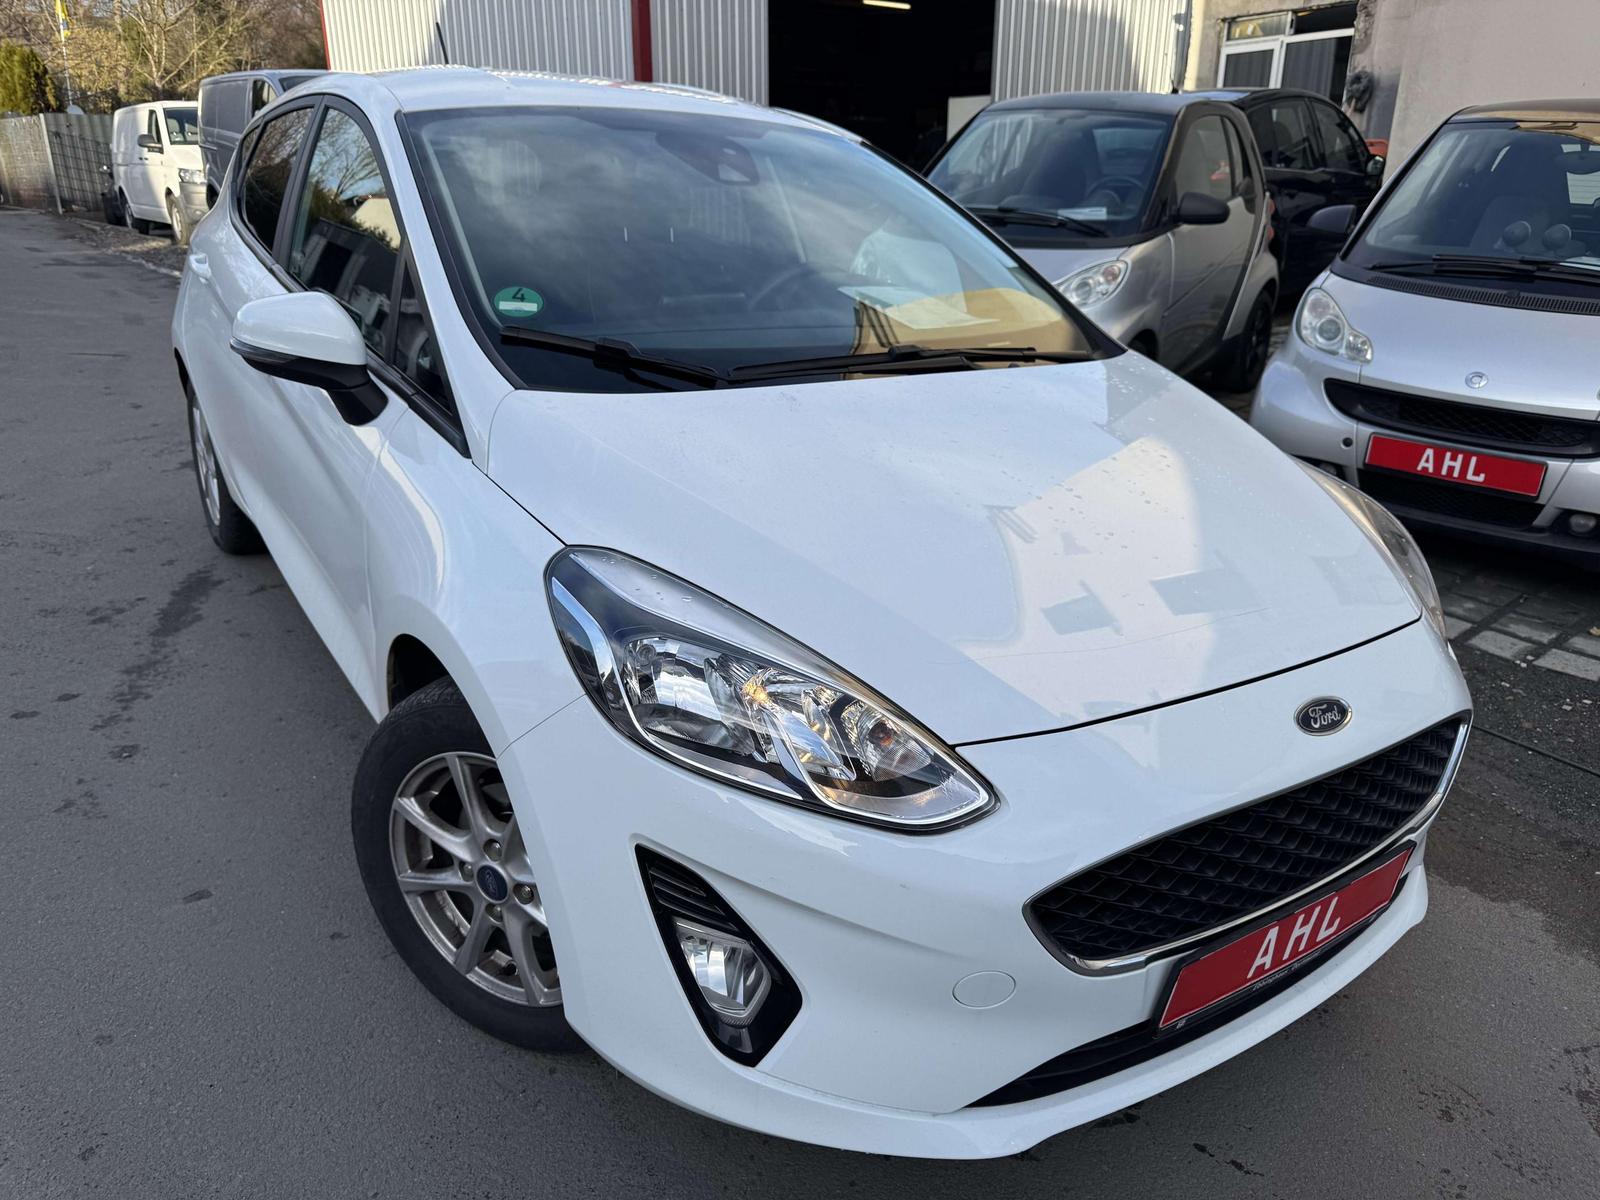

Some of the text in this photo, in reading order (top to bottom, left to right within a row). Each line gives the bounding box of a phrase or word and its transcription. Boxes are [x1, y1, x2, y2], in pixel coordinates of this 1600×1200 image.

[511, 287, 526, 303] 4
[1416, 448, 1486, 483] AHL
[1308, 703, 1341, 729] Ford
[1246, 896, 1341, 979] AHL
